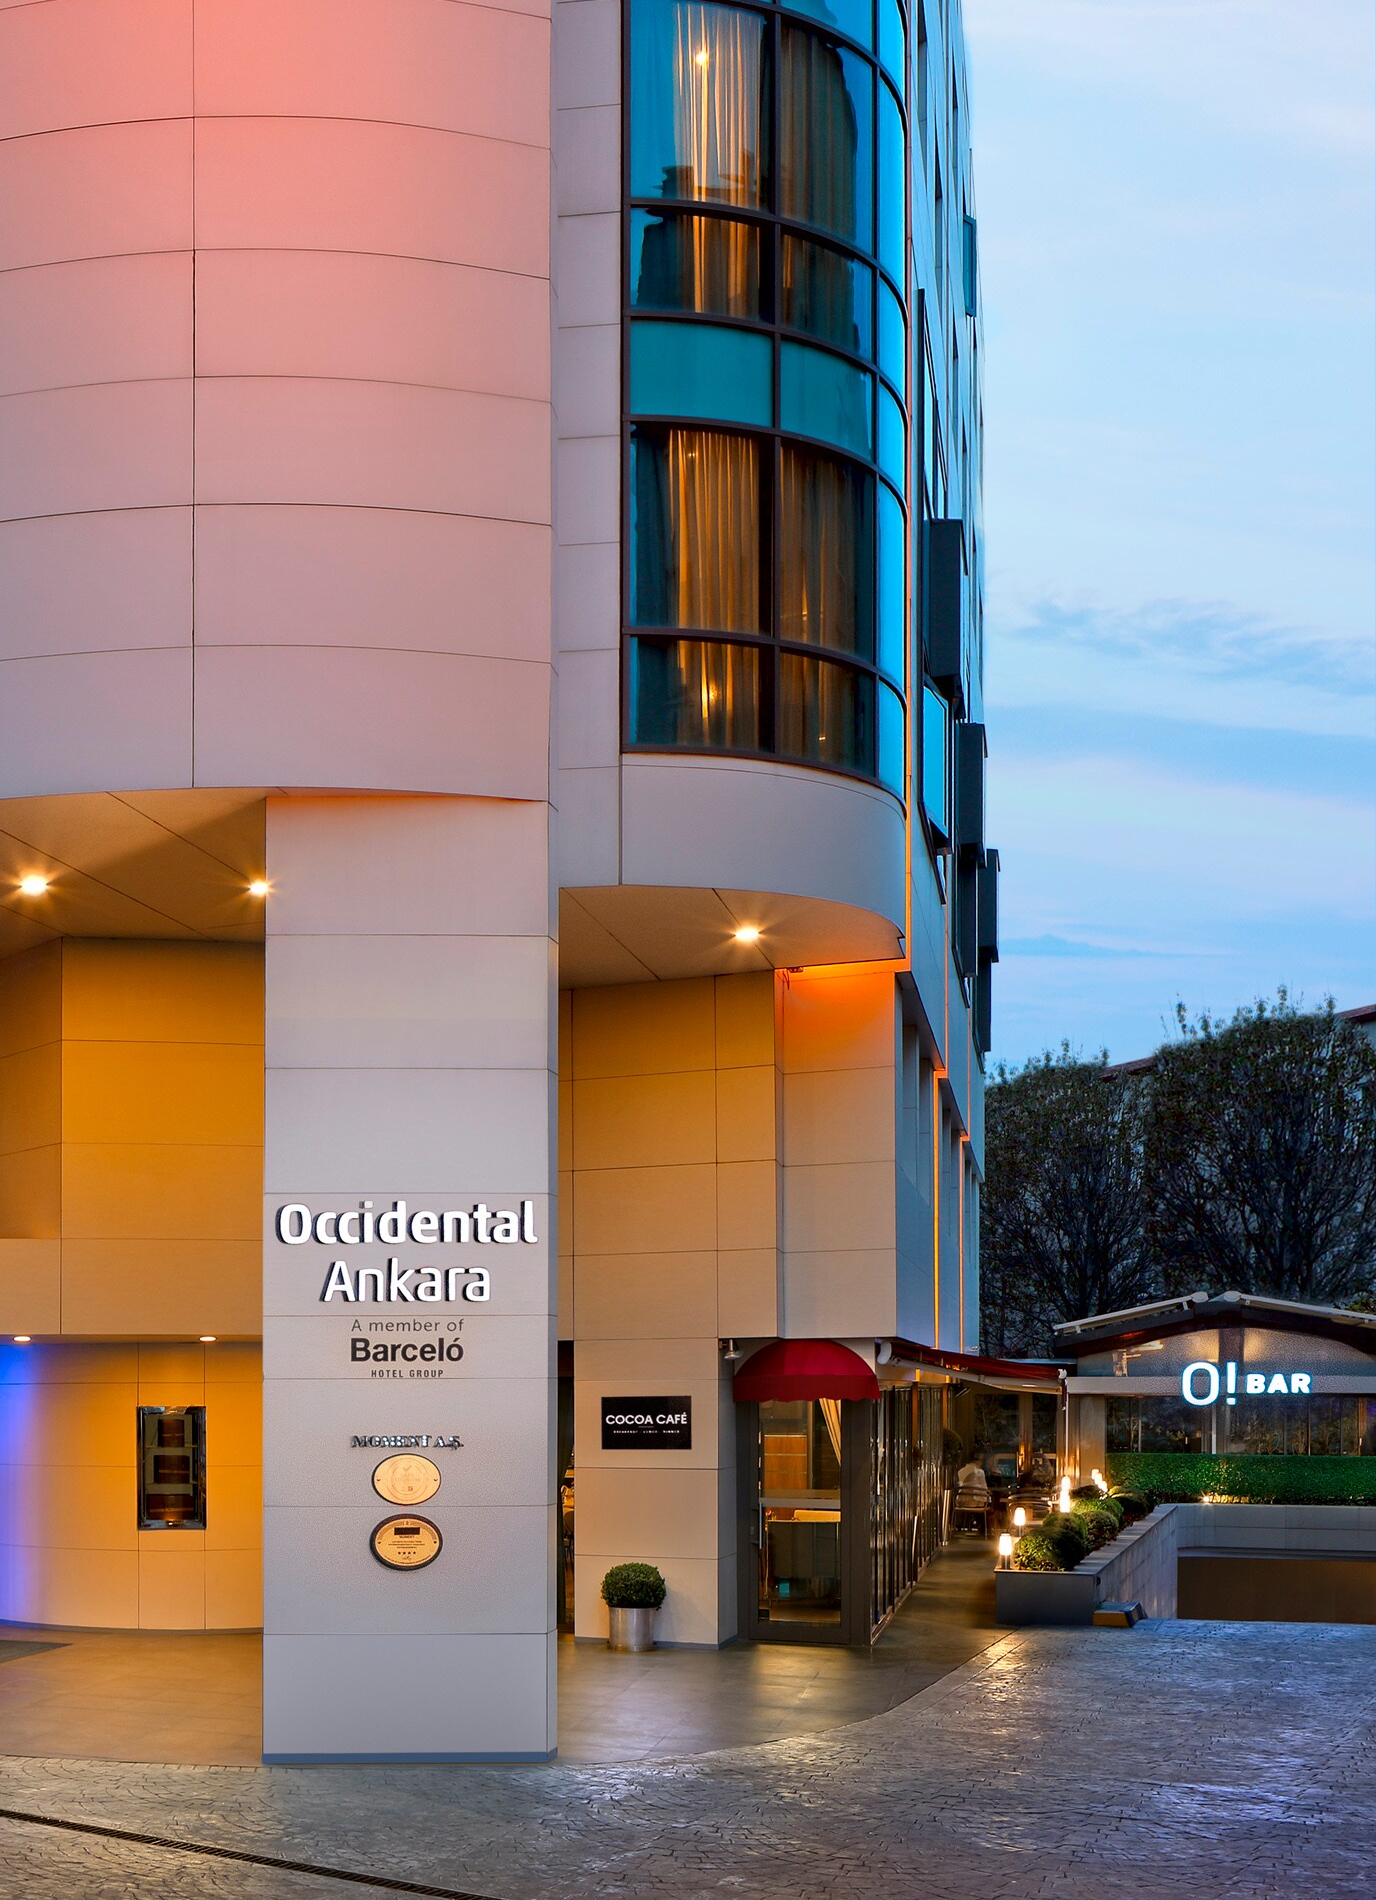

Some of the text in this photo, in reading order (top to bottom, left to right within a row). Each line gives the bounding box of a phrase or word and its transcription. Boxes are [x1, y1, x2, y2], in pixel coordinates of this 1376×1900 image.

[276, 1200, 539, 1244] Occidental
[320, 1257, 491, 1302] Ankara
[351, 1319, 464, 1332] A member of
[351, 1337, 464, 1362] Barceló
[371, 1369, 444, 1378] HOTEL GROUP
[1246, 1373, 1311, 1394] BAR
[605, 1412, 688, 1425] COCOA CAFÉ
